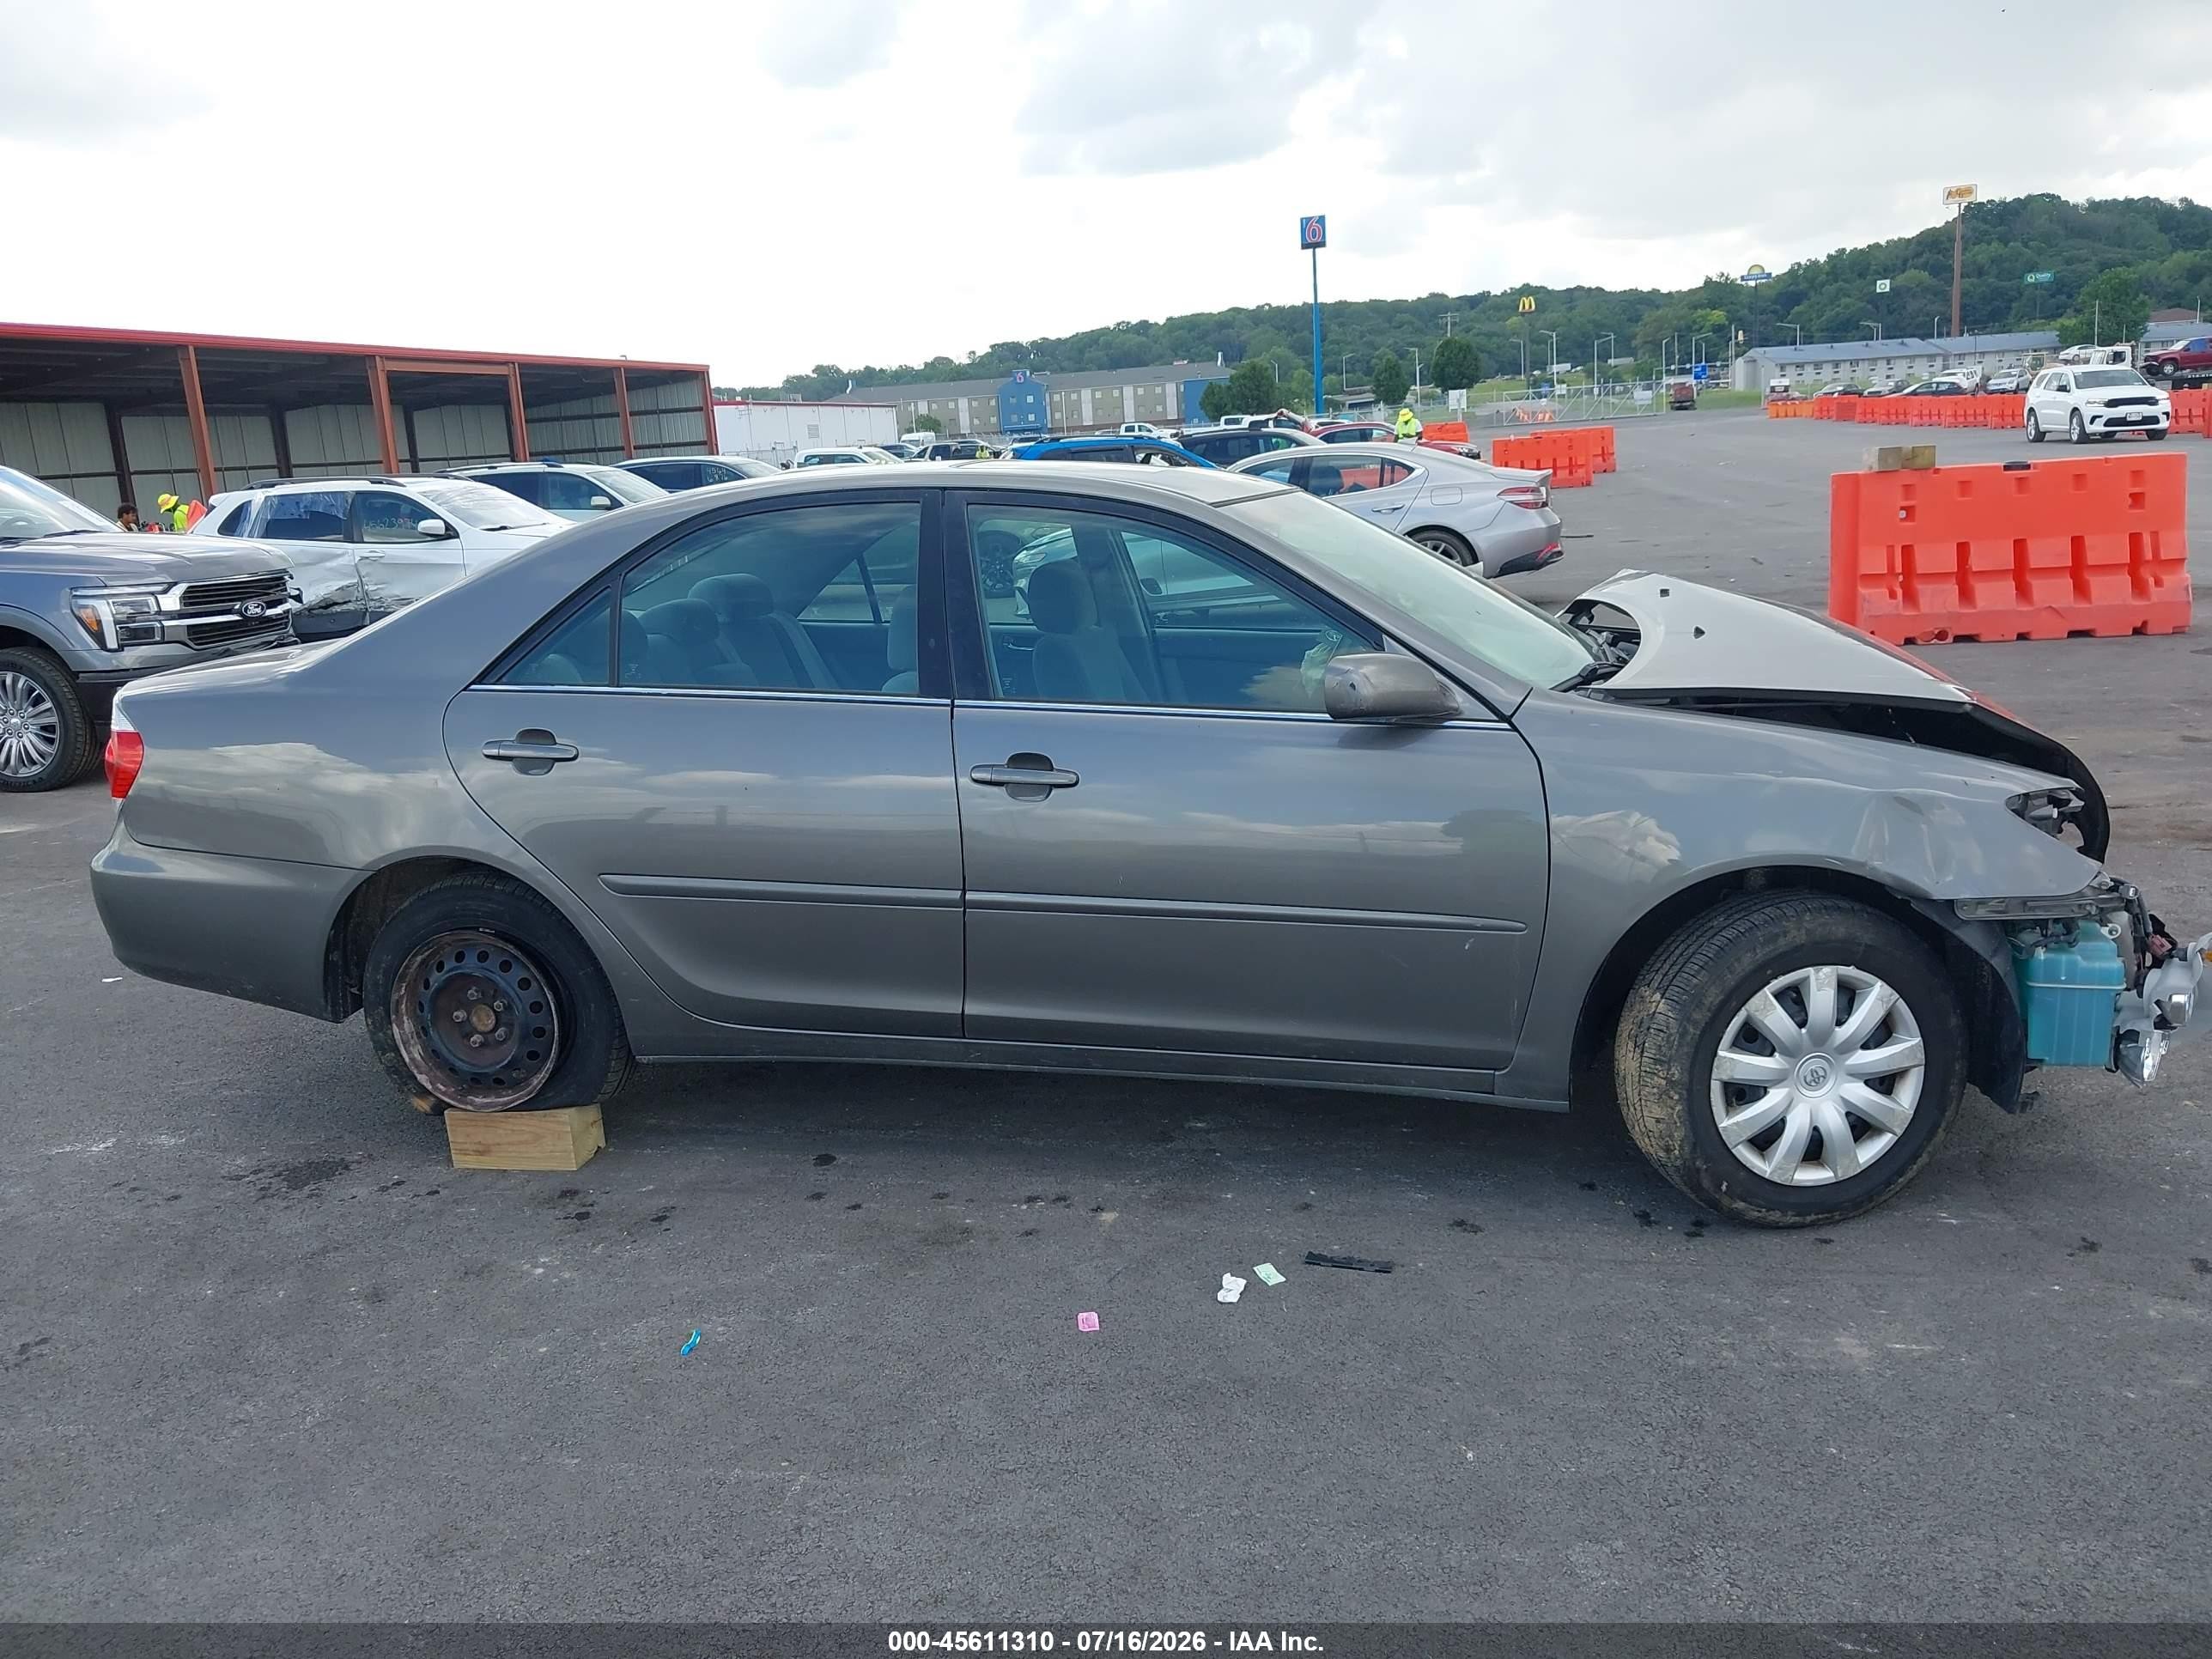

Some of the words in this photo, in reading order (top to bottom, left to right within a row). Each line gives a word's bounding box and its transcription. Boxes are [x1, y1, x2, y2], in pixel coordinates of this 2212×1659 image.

[1305, 216, 1323, 243] 6
[1016, 371, 1024, 384] 6
[246, 604, 261, 615] Ford
